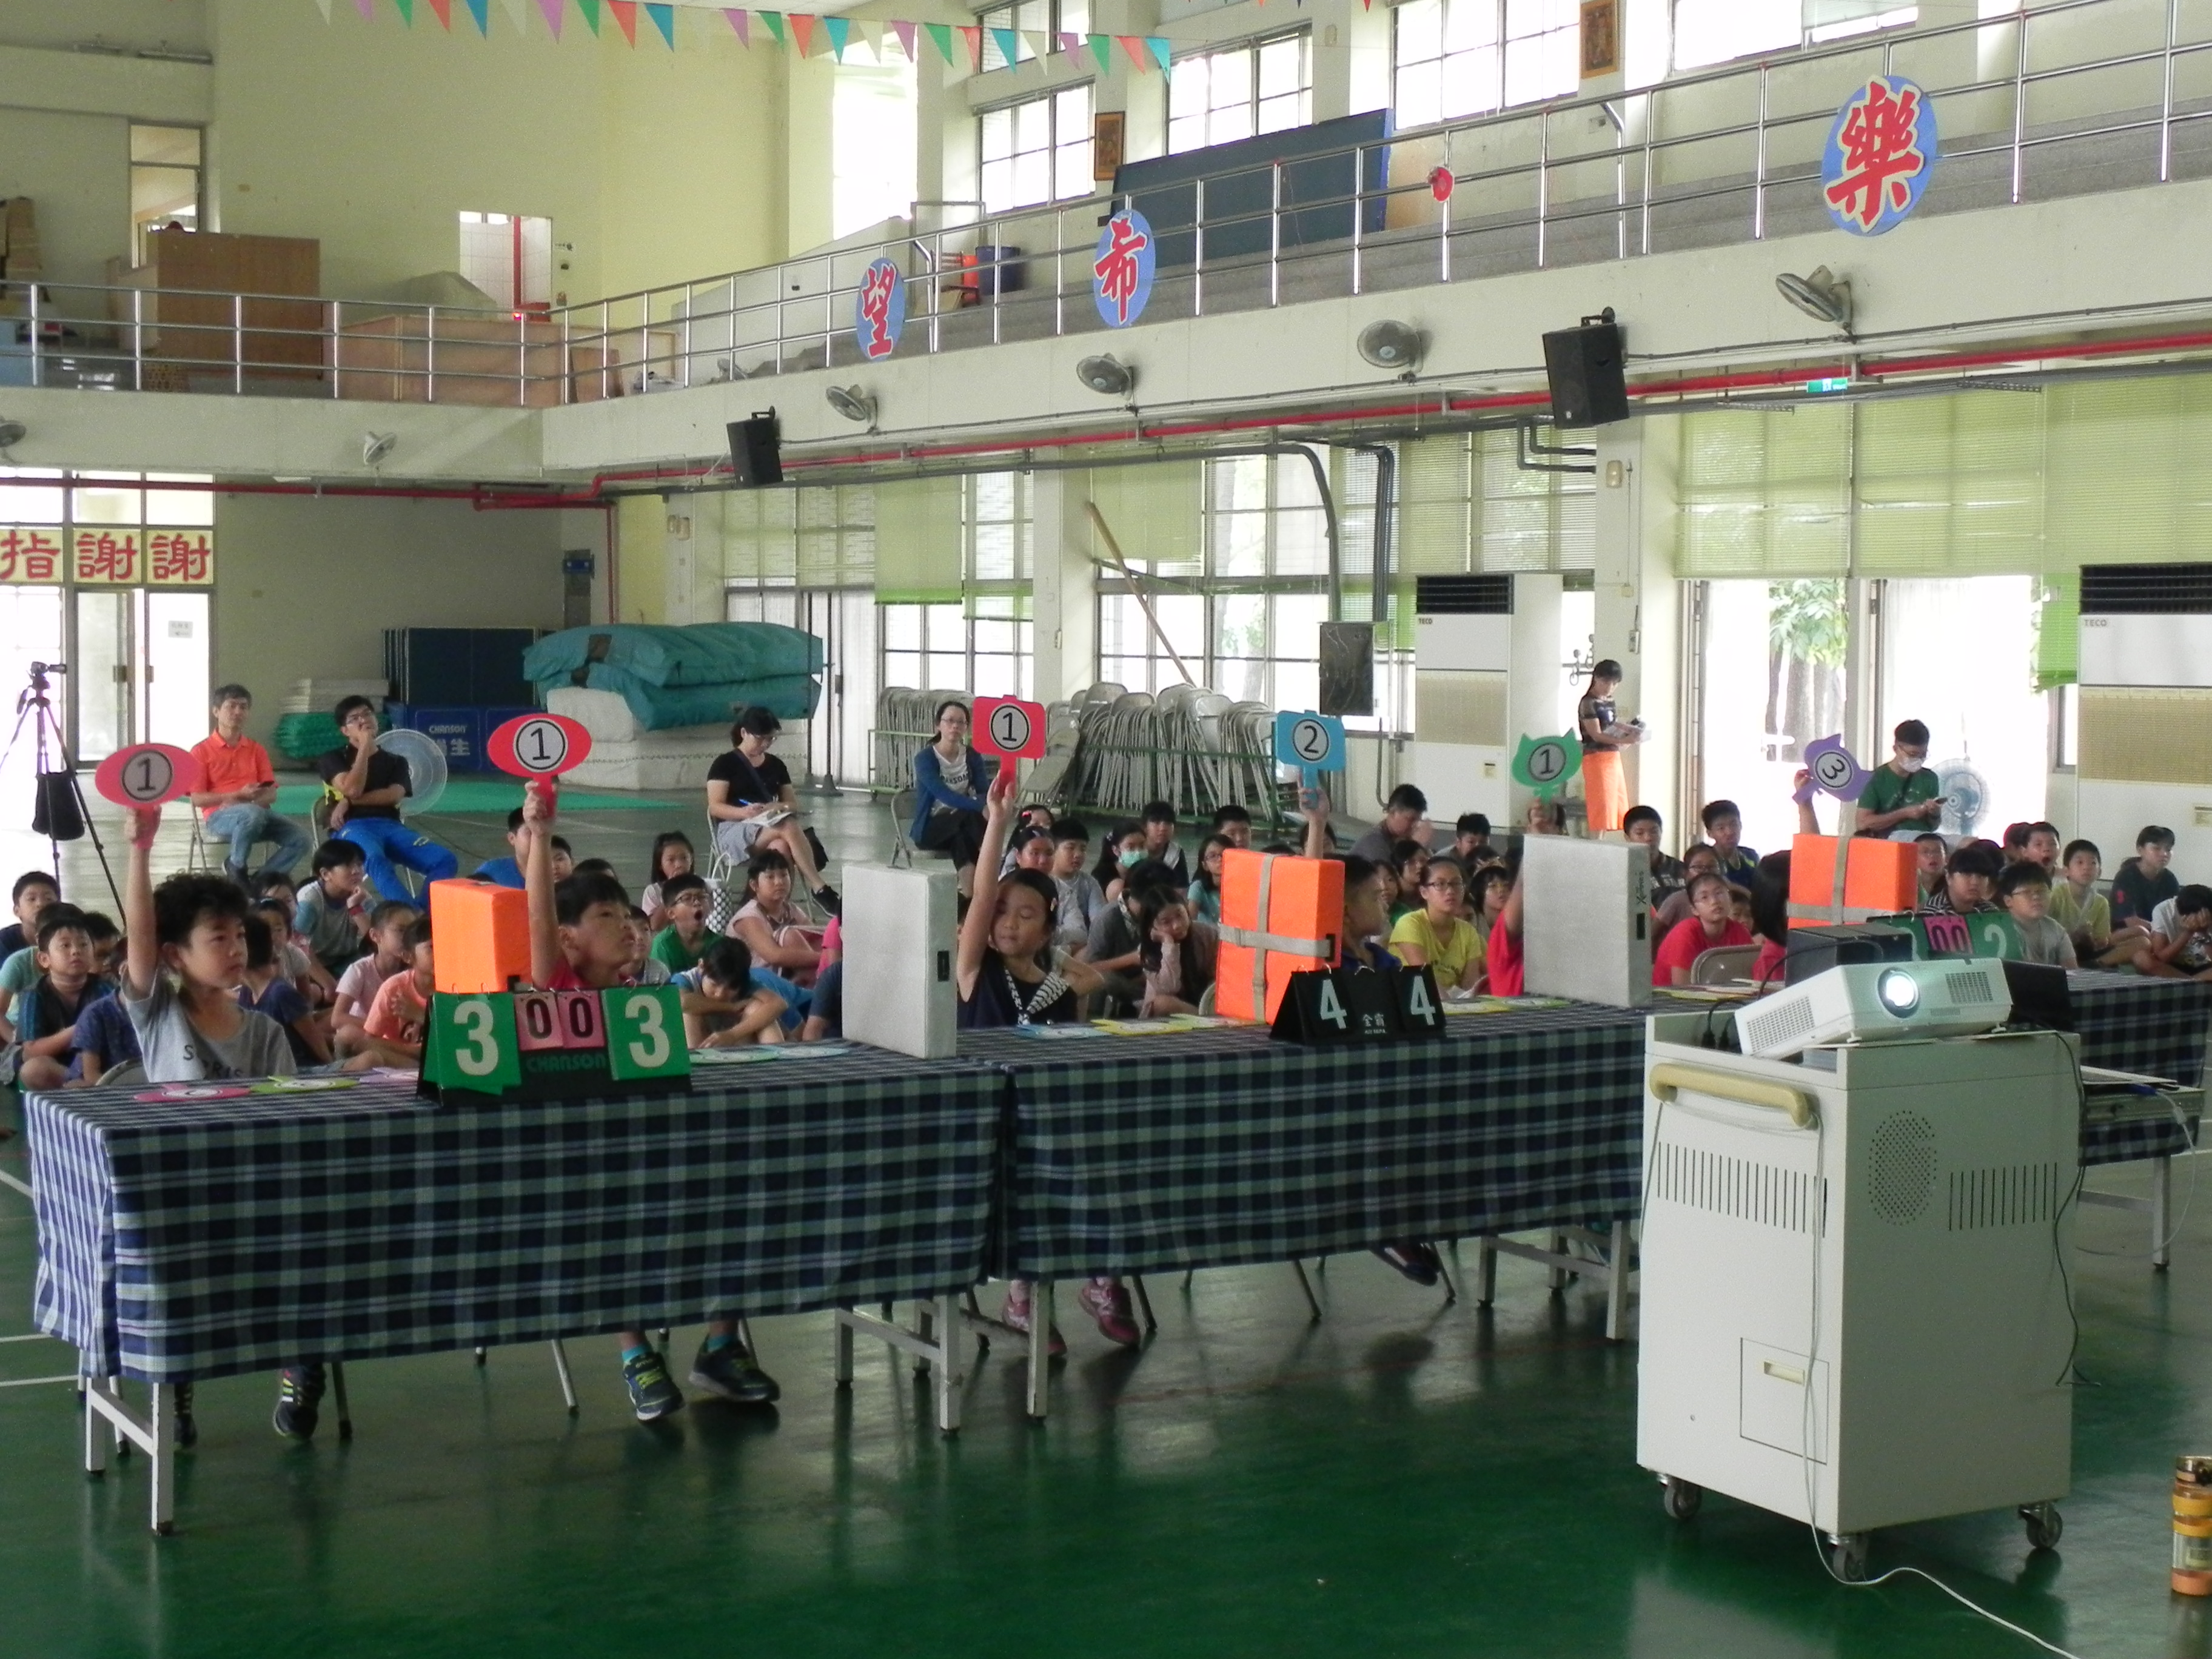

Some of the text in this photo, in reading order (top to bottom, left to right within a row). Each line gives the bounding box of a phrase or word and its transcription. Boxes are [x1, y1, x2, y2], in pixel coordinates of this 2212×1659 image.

[1825, 78, 1923, 229] 樂
[1094, 218, 1147, 324] 希
[862, 264, 896, 358] 望
[429, 725, 466, 734] CHANSON
[1002, 712, 1017, 742] 1
[1304, 725, 1319, 754] 2
[531, 728, 551, 760] 1
[137, 757, 156, 791] 1
[1540, 748, 1554, 775] 1
[1822, 759, 1845, 780] 3
[1320, 975, 1436, 1029] 4 4
[454, 1000, 499, 1076] 3
[625, 994, 671, 1068] 3
